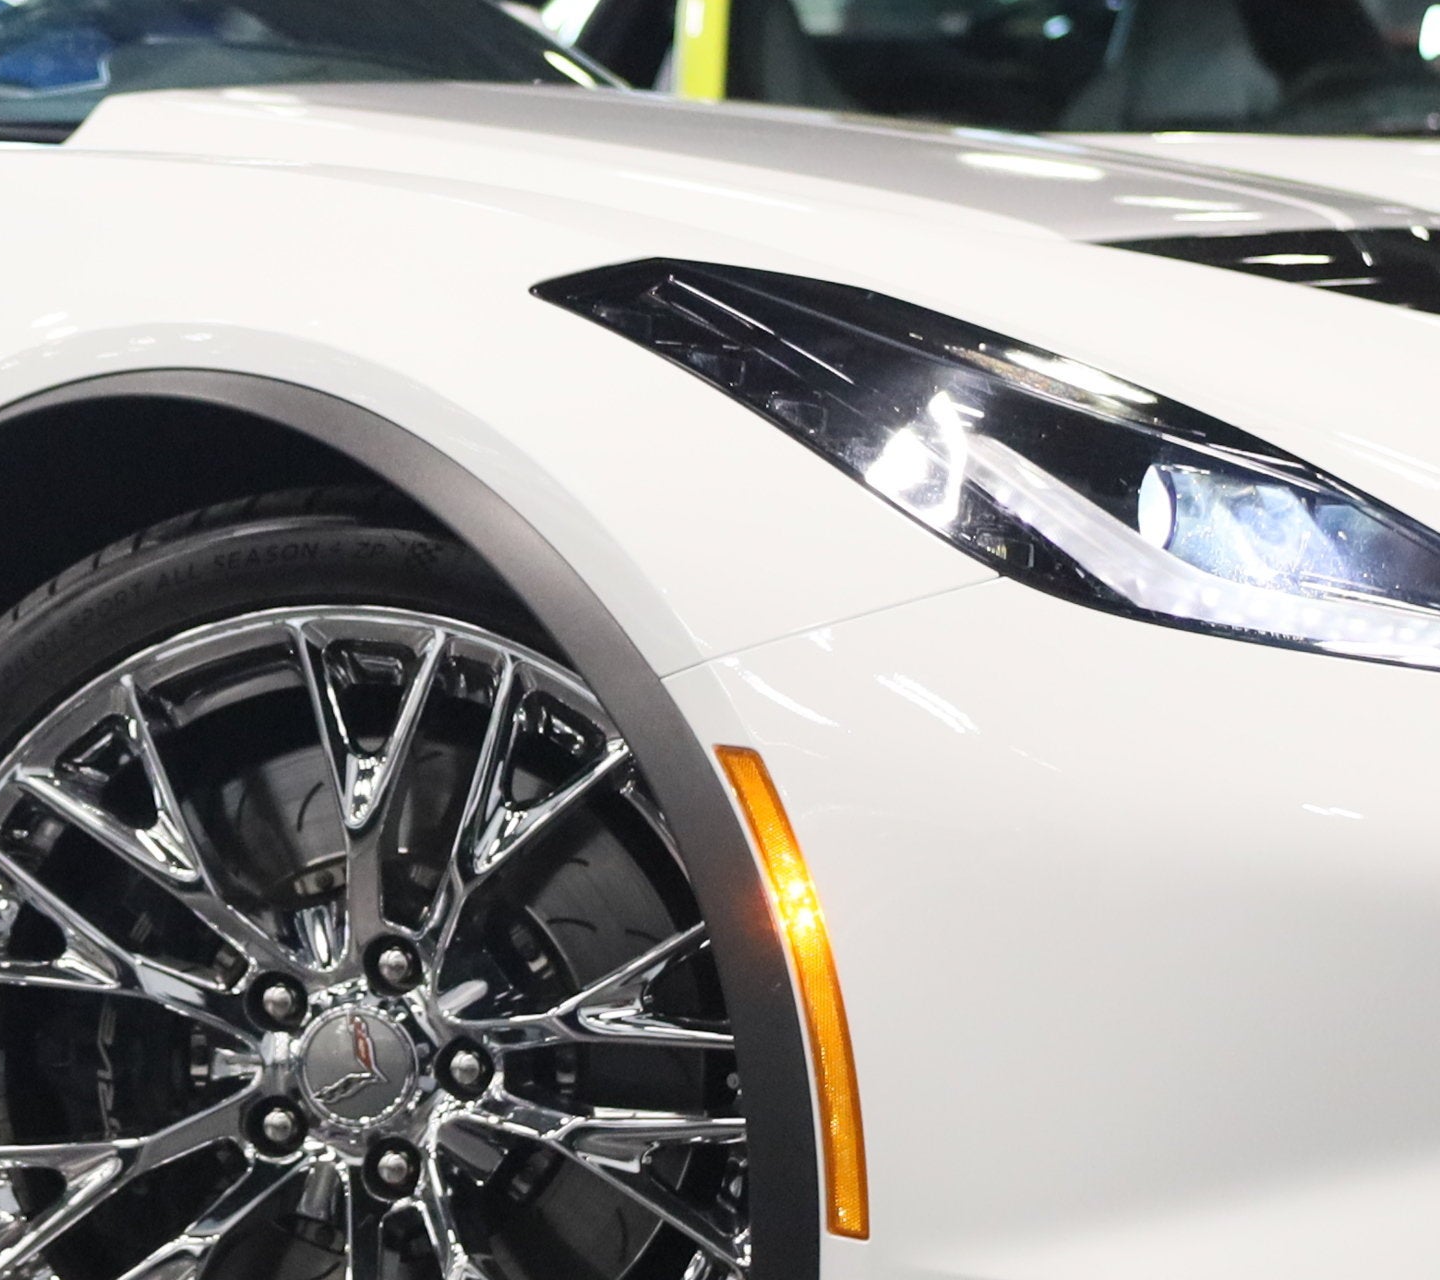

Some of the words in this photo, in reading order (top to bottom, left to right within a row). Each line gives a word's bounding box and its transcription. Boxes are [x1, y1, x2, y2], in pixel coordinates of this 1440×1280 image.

[69, 582, 146, 629] SPORT
[157, 564, 200, 591] ALL
[213, 543, 320, 570] SEASON
[354, 541, 387, 558] ZP
